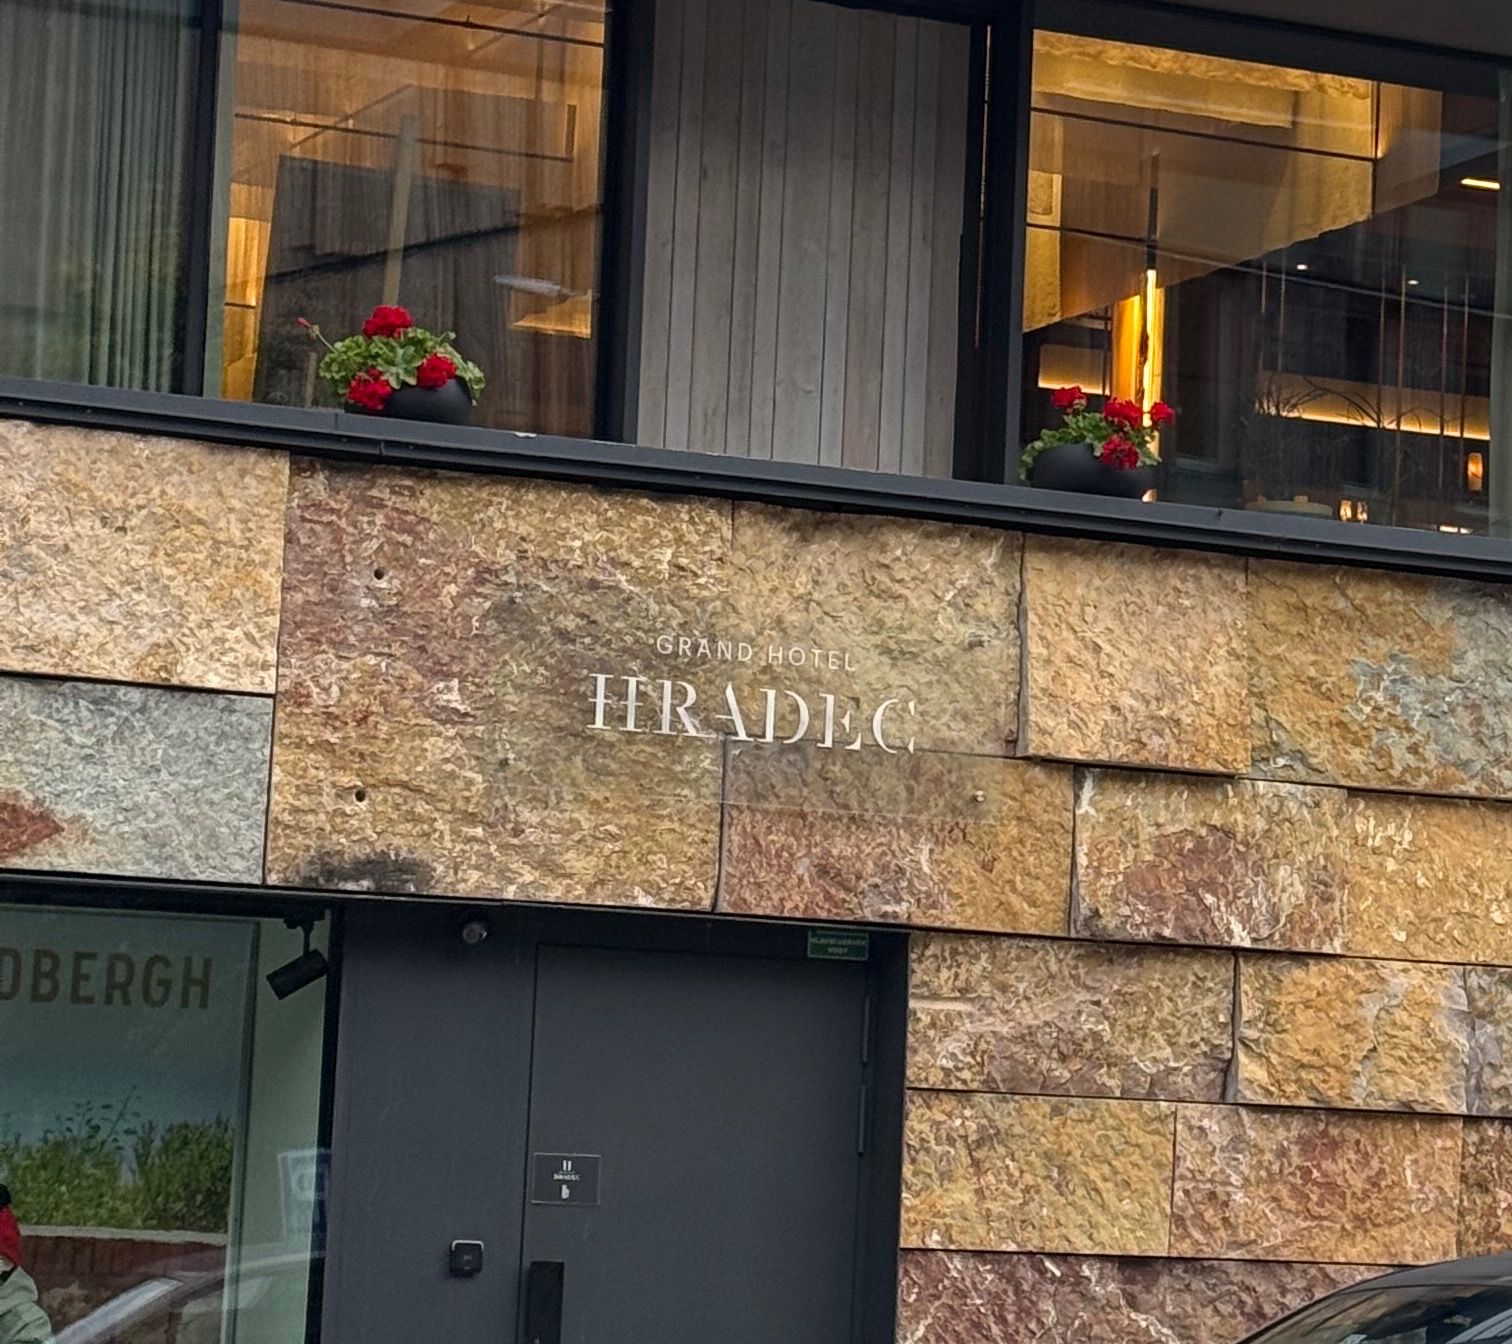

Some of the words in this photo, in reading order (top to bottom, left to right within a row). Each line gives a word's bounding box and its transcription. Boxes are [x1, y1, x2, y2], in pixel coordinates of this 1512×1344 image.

[656, 635, 753, 663] GRAND
[768, 644, 857, 672] HOTEL
[586, 672, 915, 755] HRADEC
